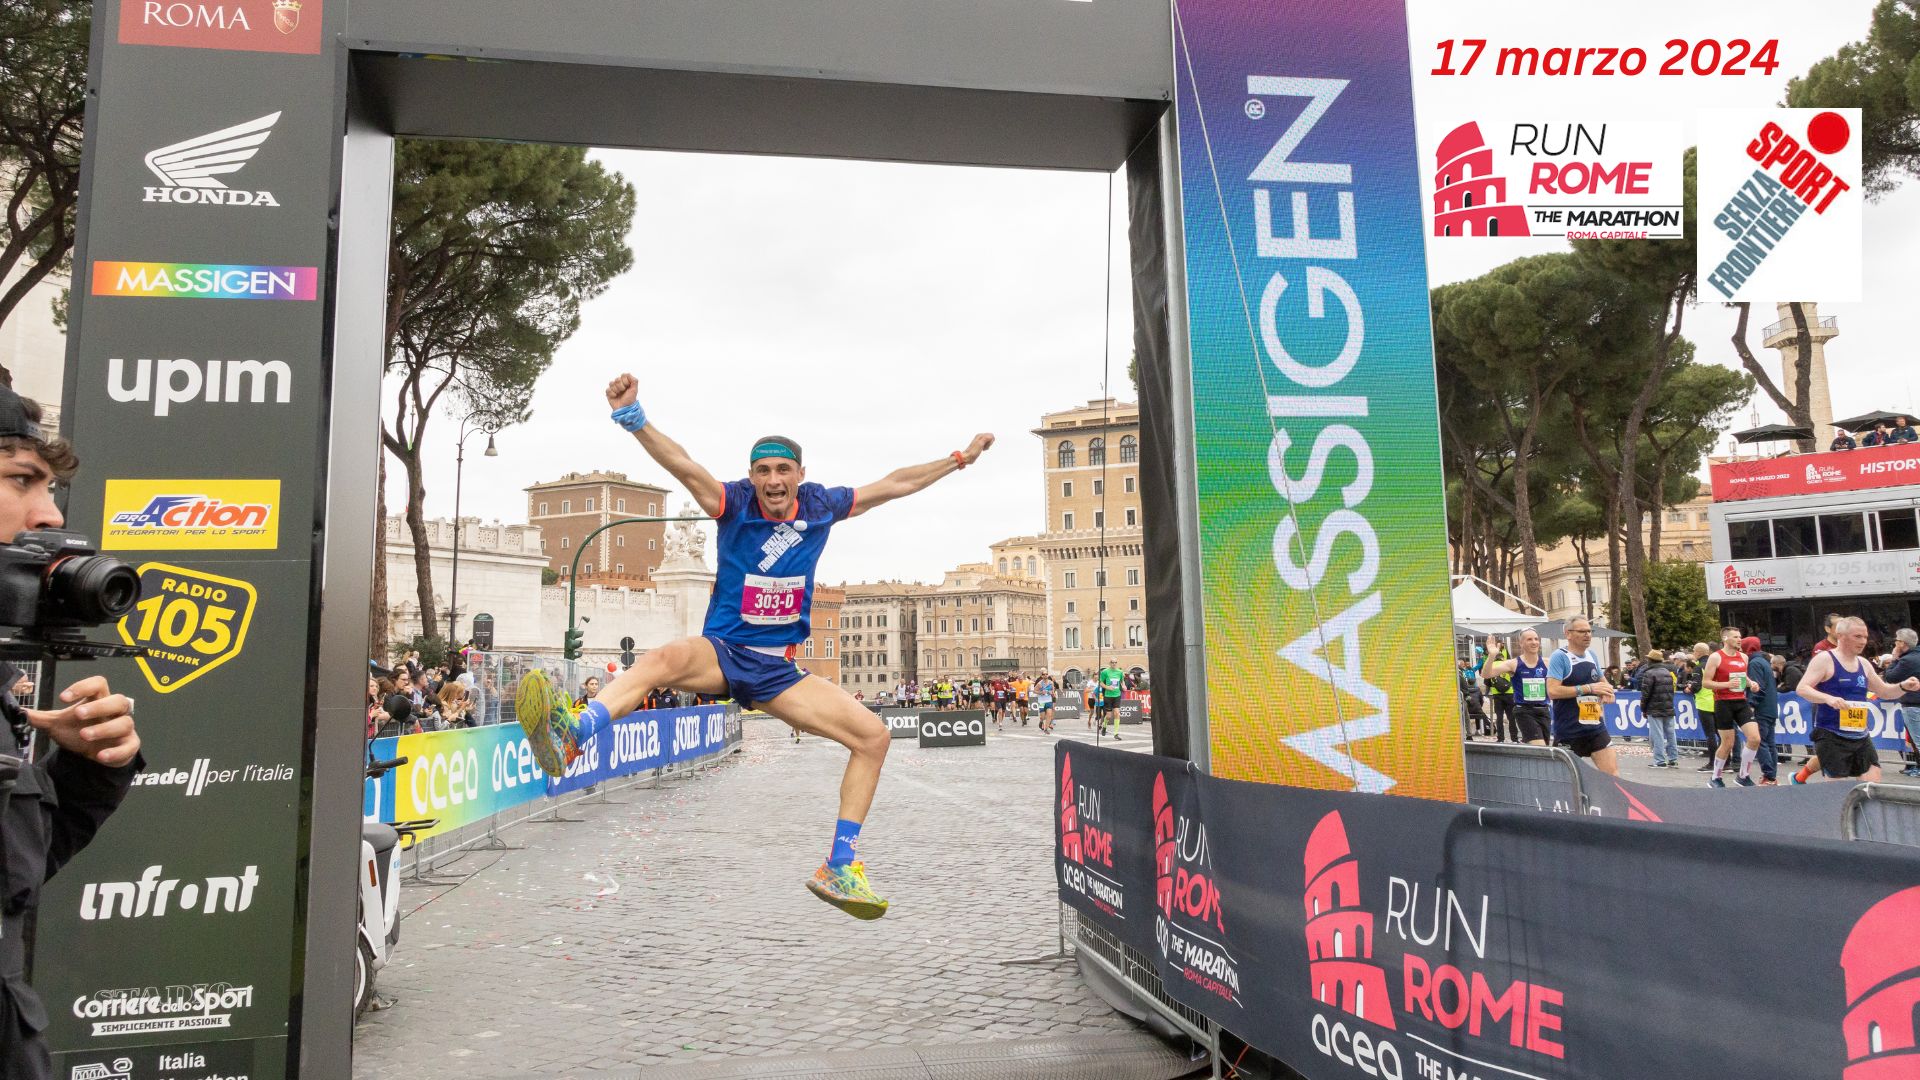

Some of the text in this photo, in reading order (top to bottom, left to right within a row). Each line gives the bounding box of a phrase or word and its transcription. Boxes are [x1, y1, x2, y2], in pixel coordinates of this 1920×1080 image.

[143, 1, 251, 31] ROMA
[142, 186, 281, 207] HONDA
[106, 358, 292, 417] upim
[1743, 570, 1766, 578] RUN
[1748, 577, 1777, 586] ROME
[1866, 560, 1896, 574] km
[161, 578, 228, 602] RADIO
[754, 593, 795, 609] 303-D
[136, 594, 237, 655] 105
[921, 719, 983, 738] acea
[1615, 700, 1698, 731] Joa
[204, 769, 240, 787] per
[411, 747, 479, 816] acea
[1078, 784, 1101, 823] RUN
[1083, 823, 1113, 869] ROME
[1063, 862, 1086, 896] acea
[1092, 877, 1123, 910] MARATHON
[1385, 876, 1489, 960] RUN
[1171, 933, 1185, 955] THE
[72, 985, 254, 1019] Corriere dello Sport
[1402, 952, 1566, 1061] ROME
[100, 1017, 223, 1033] SEMPLICEMENTE PASSIONE
[159, 1052, 207, 1071] Italia
[1311, 1013, 1403, 1080] acea
